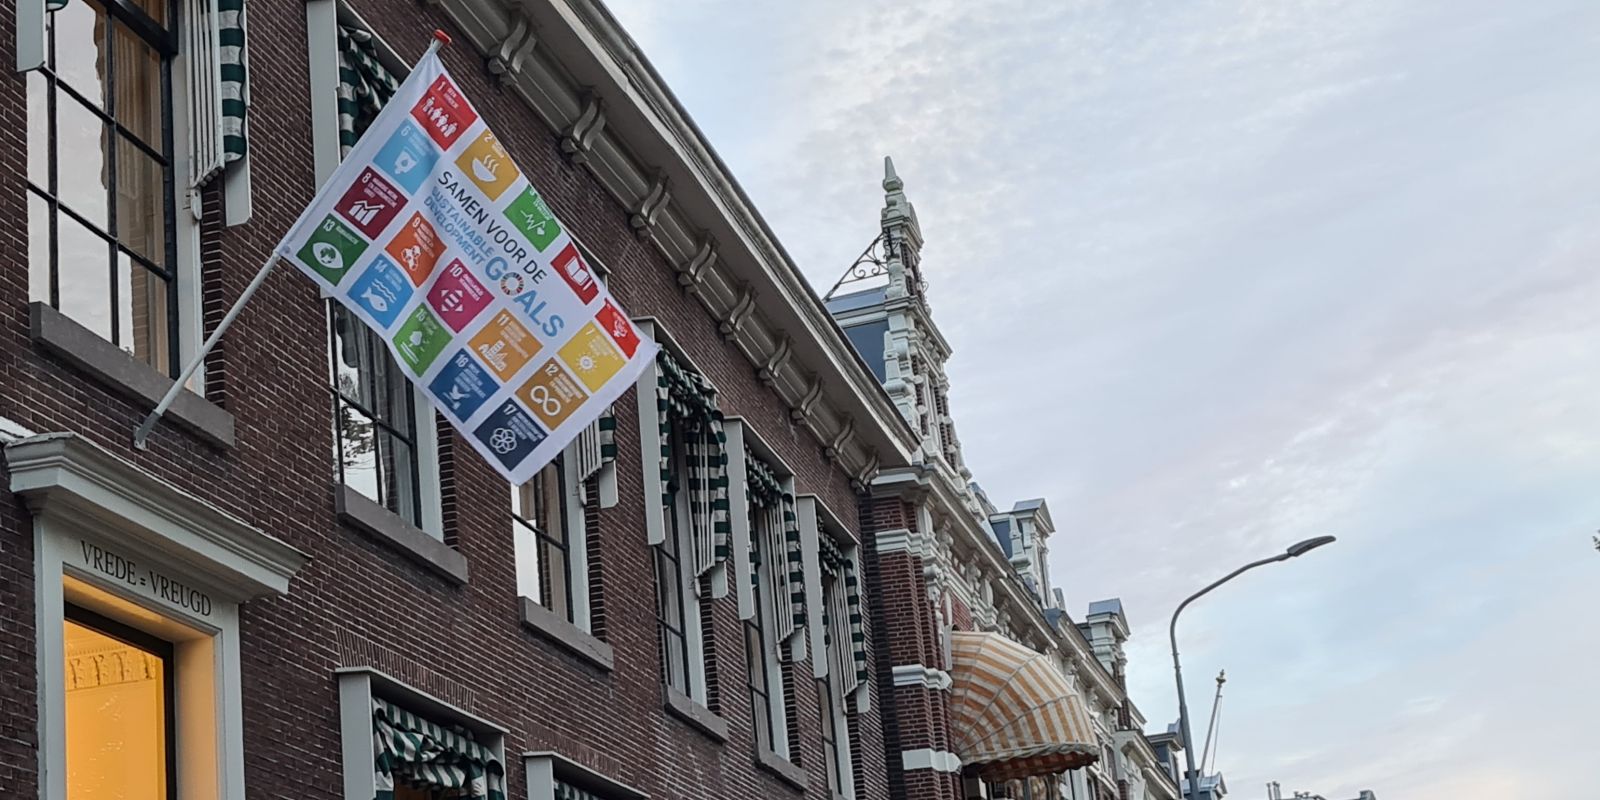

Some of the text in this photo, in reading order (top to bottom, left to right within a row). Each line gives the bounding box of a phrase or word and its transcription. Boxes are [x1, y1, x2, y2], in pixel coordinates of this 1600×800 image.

[401, 125, 411, 137] 6
[484, 133, 493, 143] 2
[362, 172, 372, 184] 8
[322, 219, 336, 232] 13
[412, 217, 421, 228] 9
[431, 185, 495, 258] SUSTAINABLE
[438, 171, 489, 225] SAMEN
[486, 219, 527, 264] VOOR
[523, 259, 547, 285] DE
[423, 195, 487, 266] DEVELOPMENT
[374, 260, 388, 273] 14
[449, 263, 463, 277] 10
[485, 256, 565, 338] GOALS
[497, 314, 510, 326] 11
[544, 363, 559, 376] 12
[503, 404, 517, 416] 17
[80, 540, 137, 586] VREDE
[149, 570, 212, 617] VREUGD
